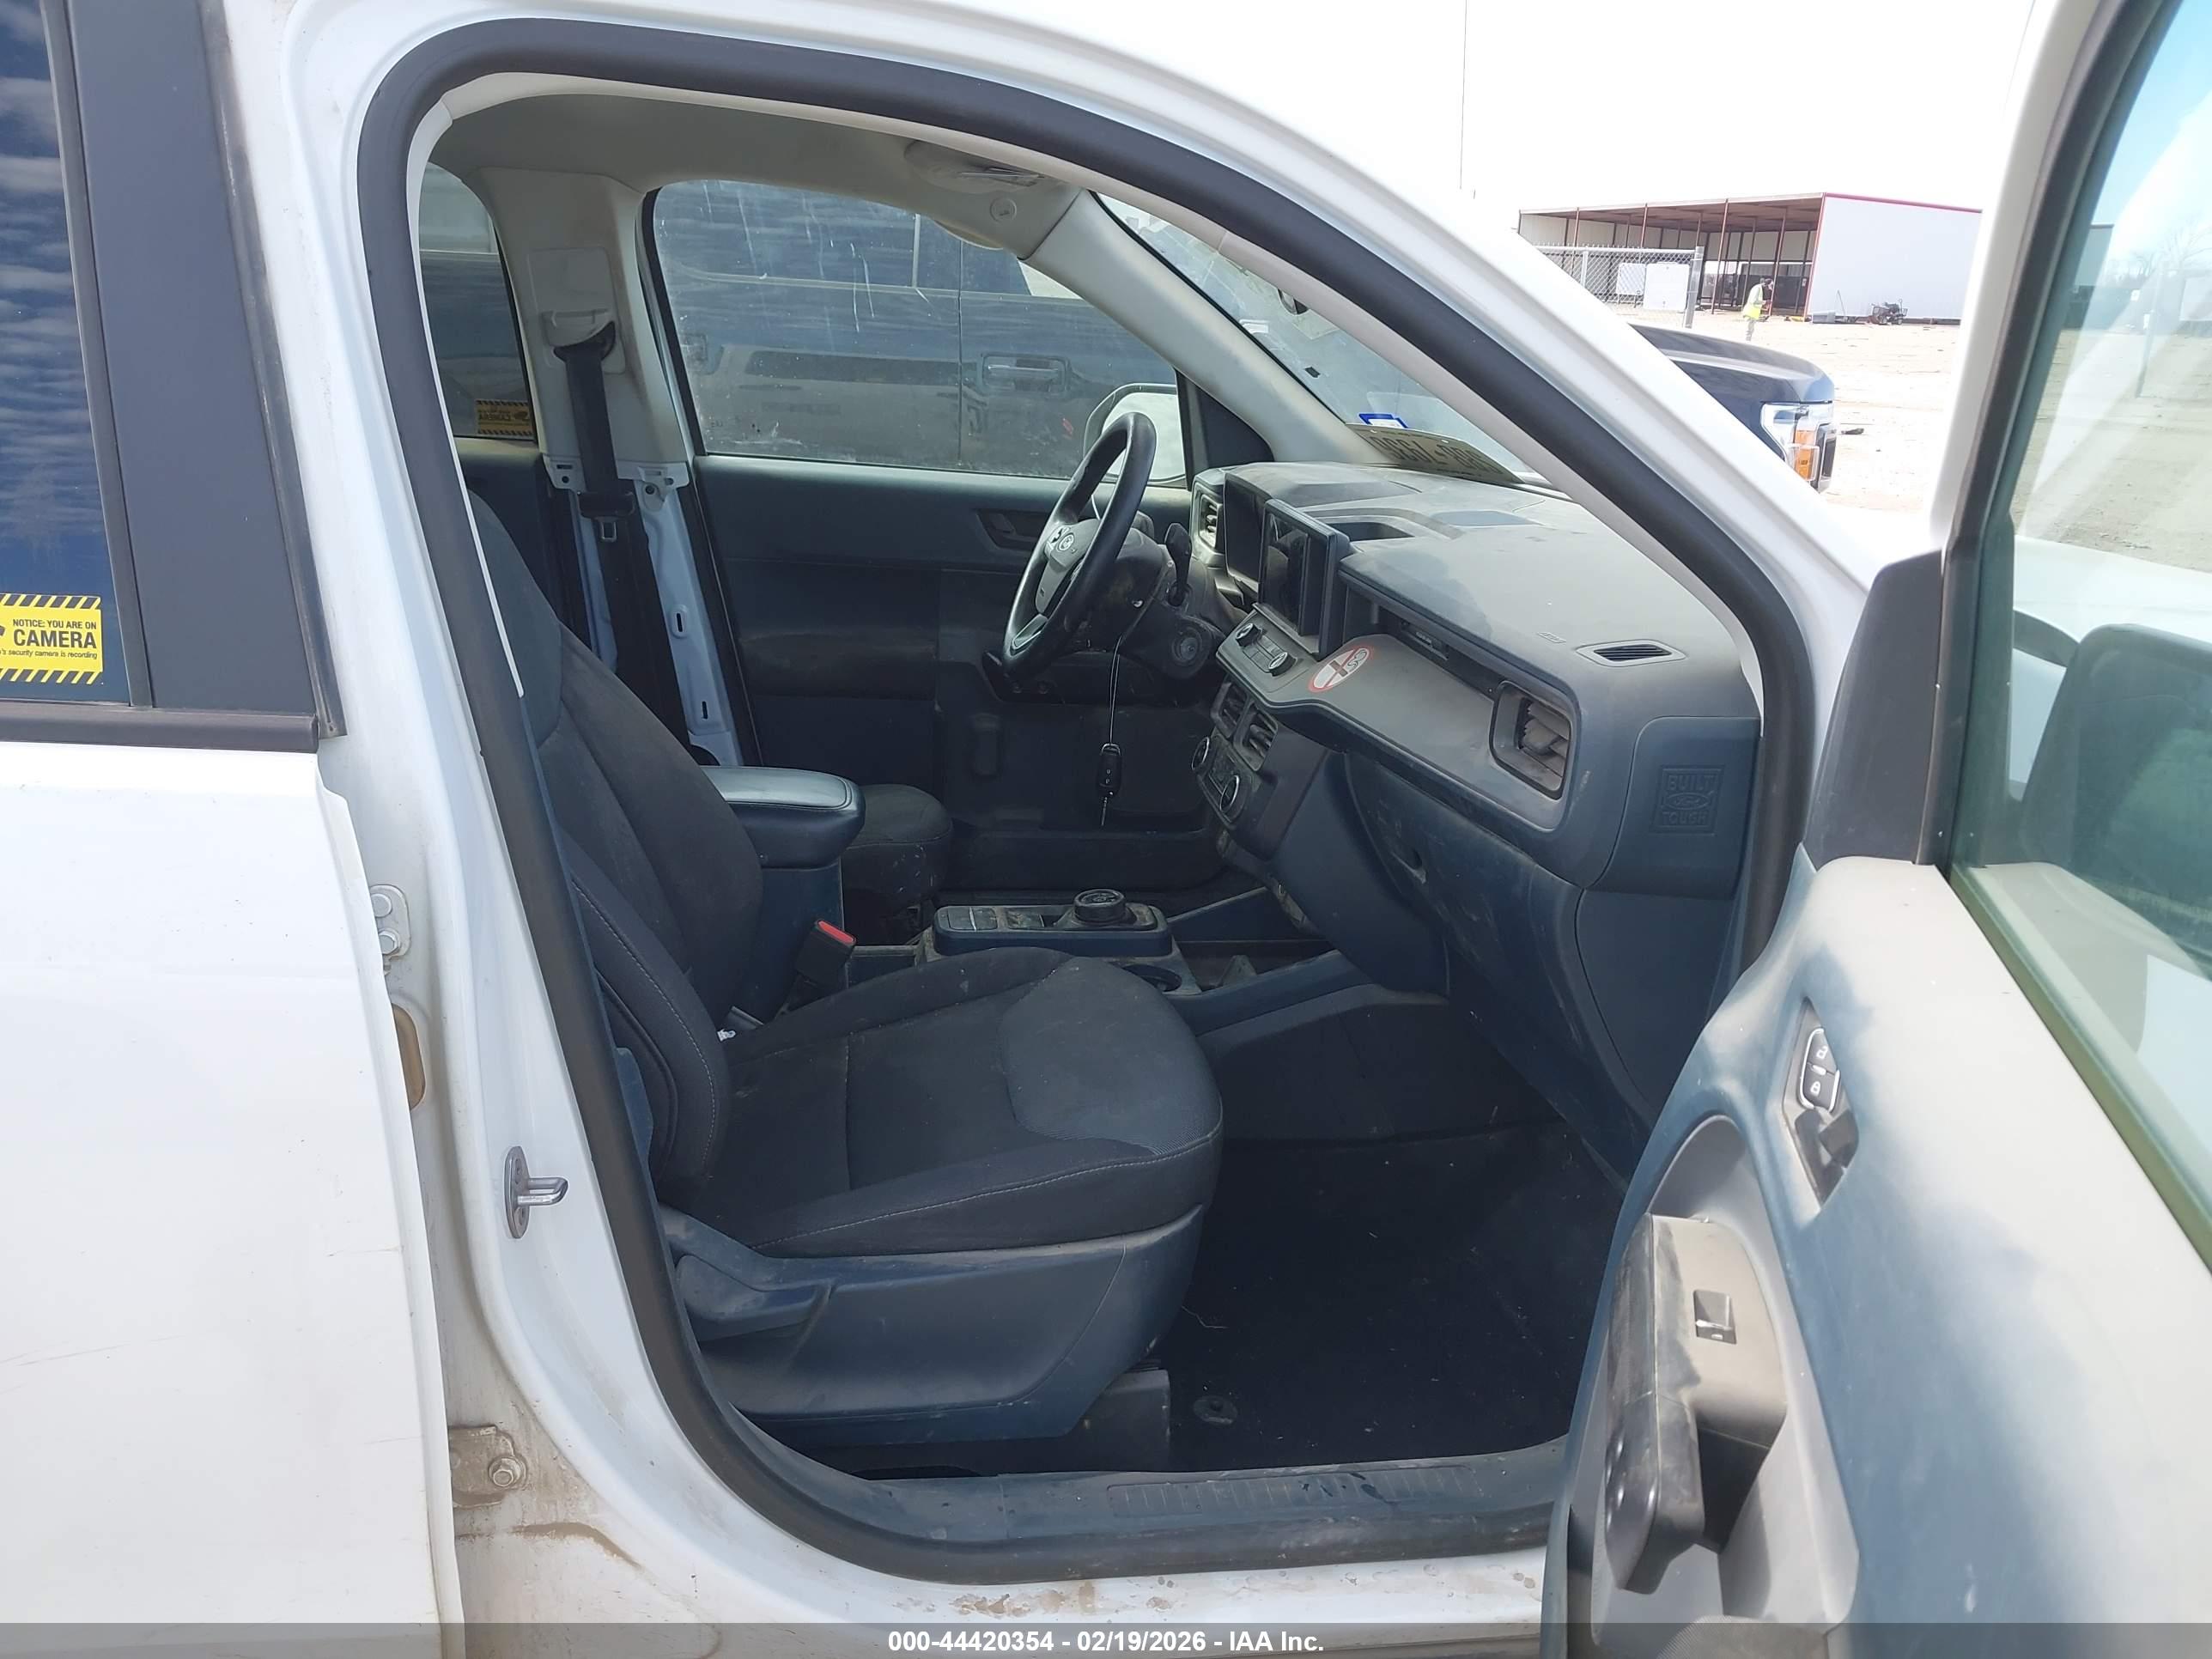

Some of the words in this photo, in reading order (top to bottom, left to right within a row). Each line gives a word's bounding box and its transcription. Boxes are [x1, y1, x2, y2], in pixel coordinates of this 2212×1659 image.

[13, 619, 45, 628] NOTICE:
[47, 620, 64, 629] YOU
[66, 621, 82, 629] ARE
[14, 629, 97, 649] CAMERA
[68, 652, 98, 660] recording
[1668, 775, 1714, 790] BUILT
[1662, 811, 1707, 824] TOUGH
